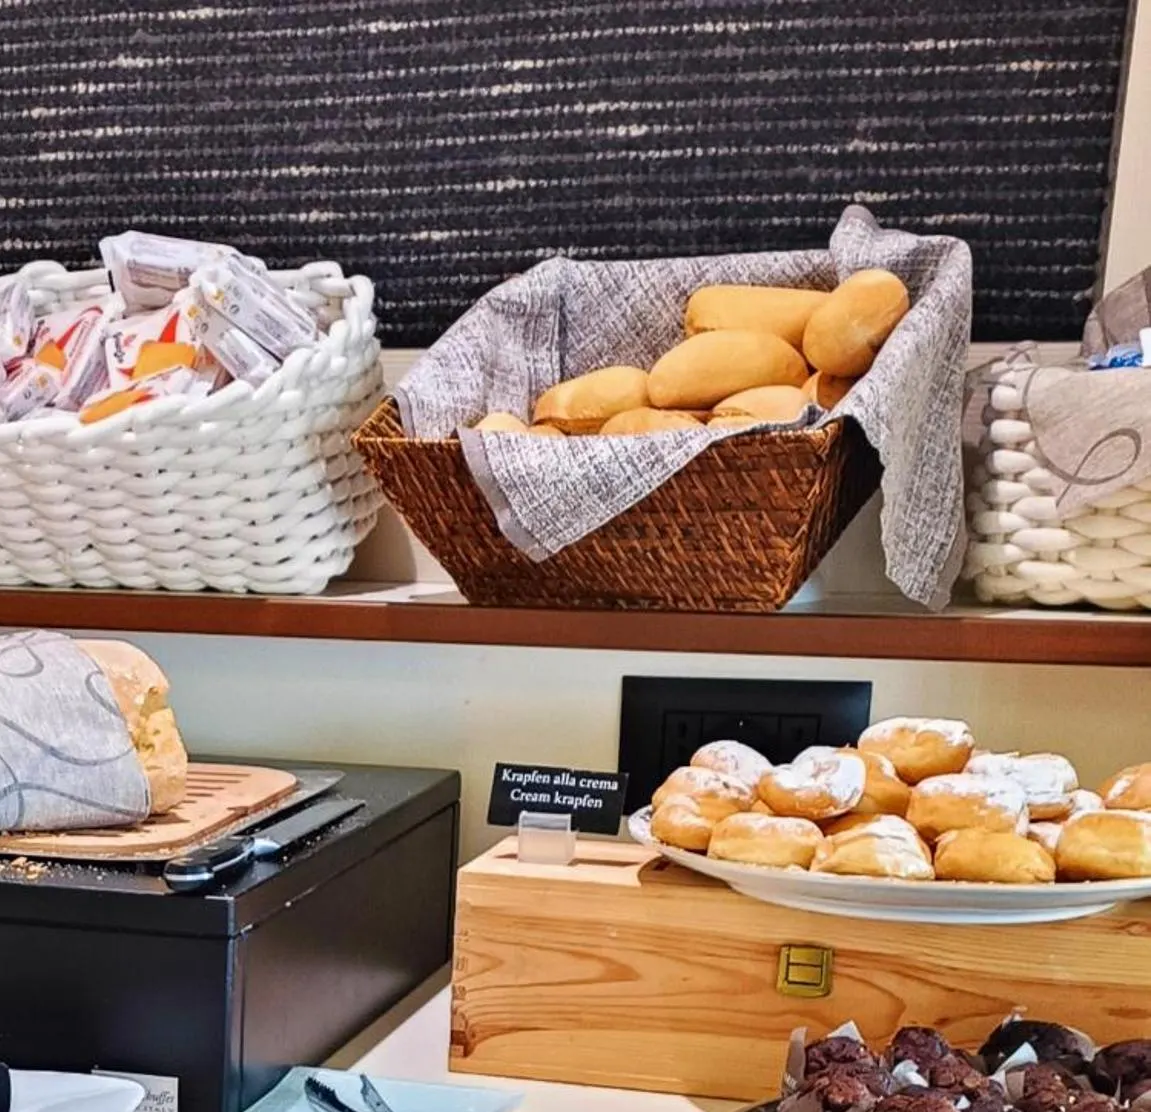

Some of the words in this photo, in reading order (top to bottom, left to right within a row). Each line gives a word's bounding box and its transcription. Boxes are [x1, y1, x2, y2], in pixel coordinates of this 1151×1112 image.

[501, 768, 552, 786] Krapfen
[553, 772, 576, 787] alla
[579, 777, 619, 791] crema
[510, 788, 551, 803] Cream
[553, 790, 604, 809] krapfen
